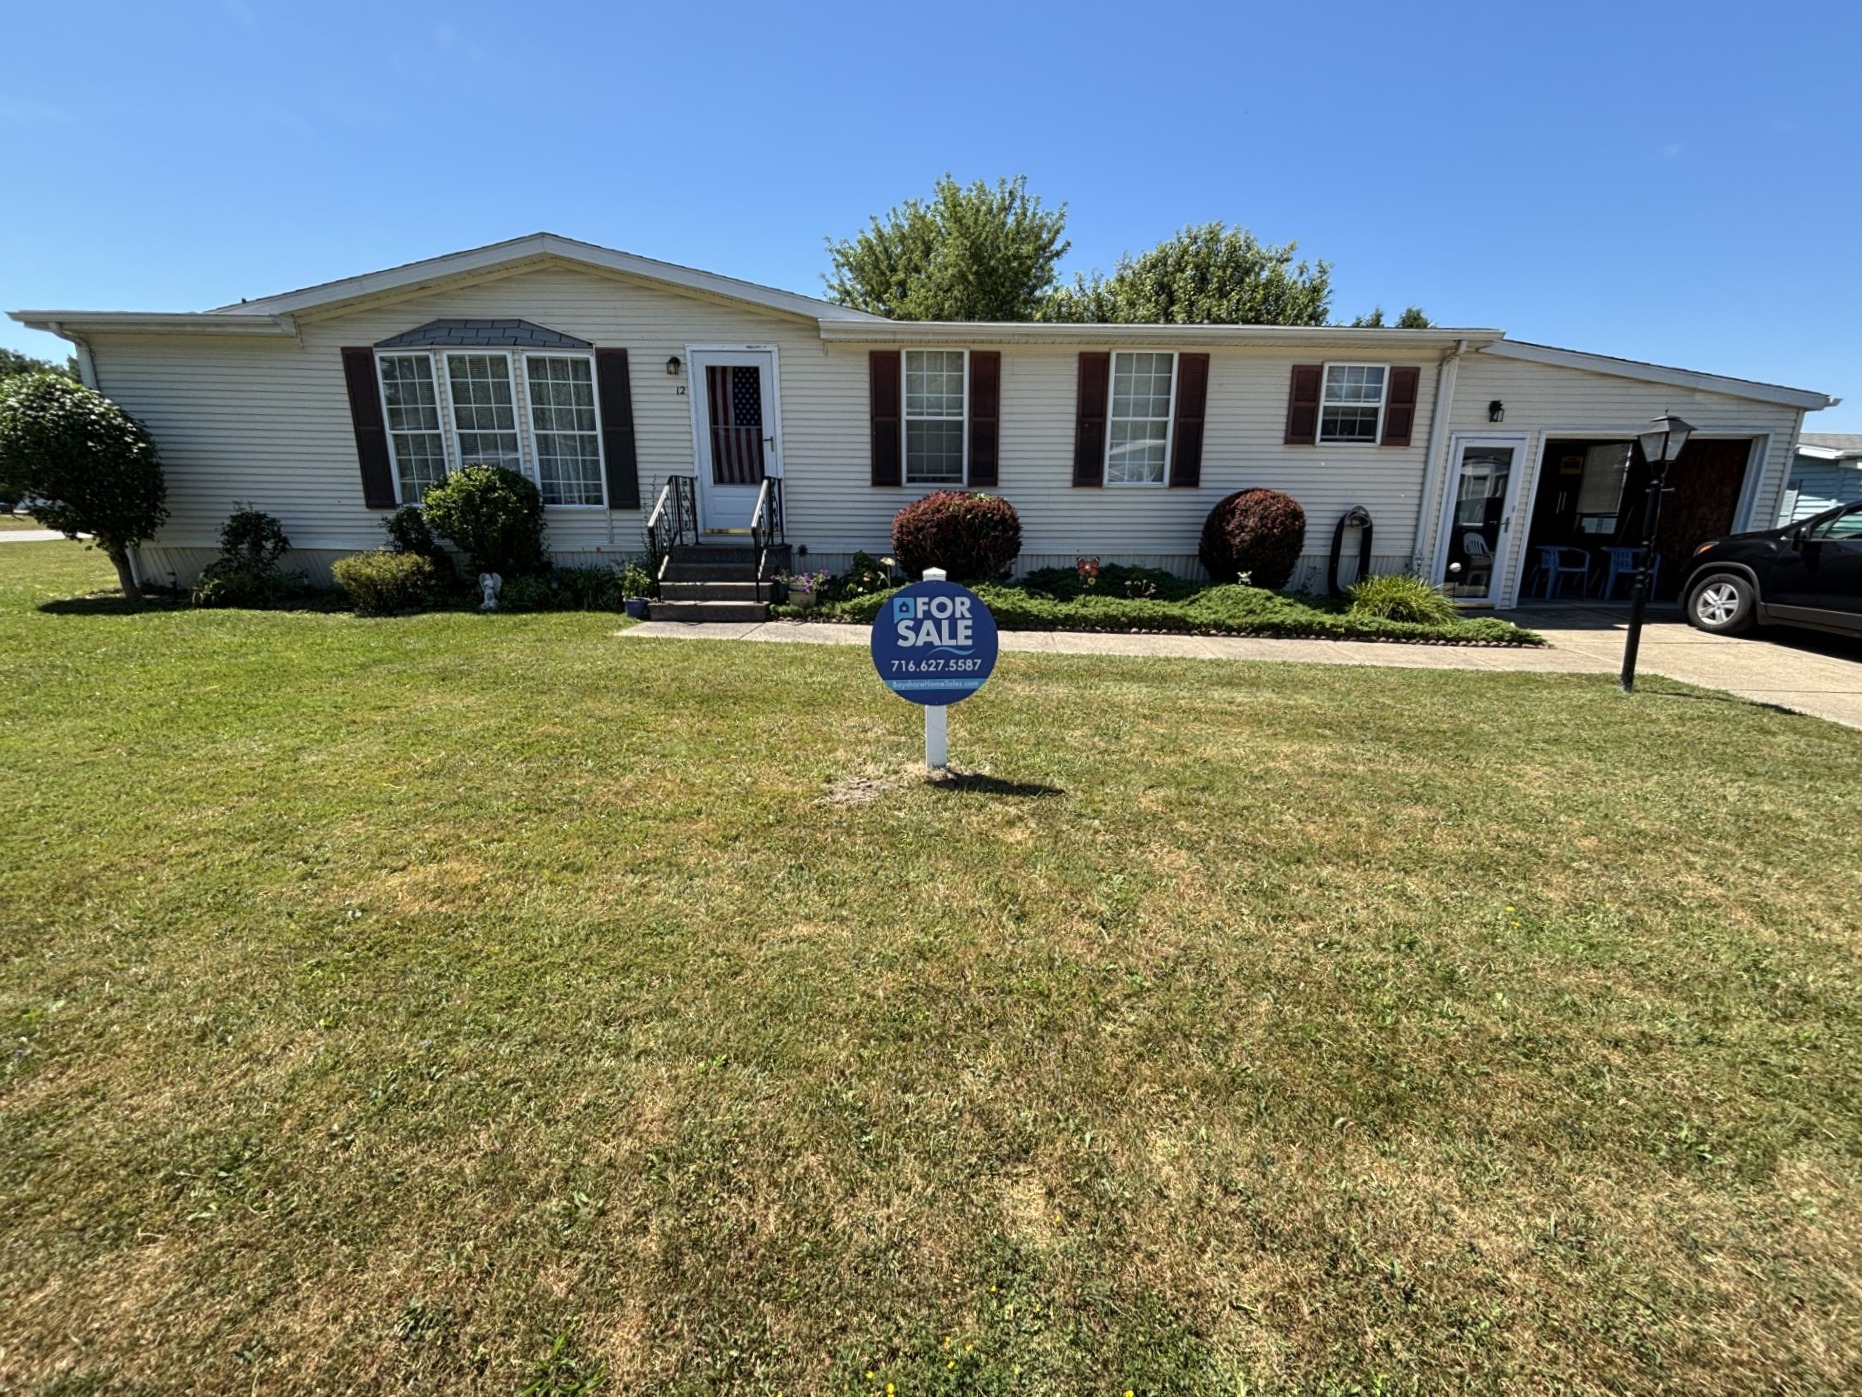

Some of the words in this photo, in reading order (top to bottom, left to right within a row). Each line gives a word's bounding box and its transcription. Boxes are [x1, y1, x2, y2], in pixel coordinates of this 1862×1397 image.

[676, 385, 686, 396] 12
[916, 596, 972, 619] FOR
[896, 619, 973, 647] SALE
[891, 659, 982, 672] 716.627.5587
[892, 680, 979, 689] BayshoreHomeSales.com
